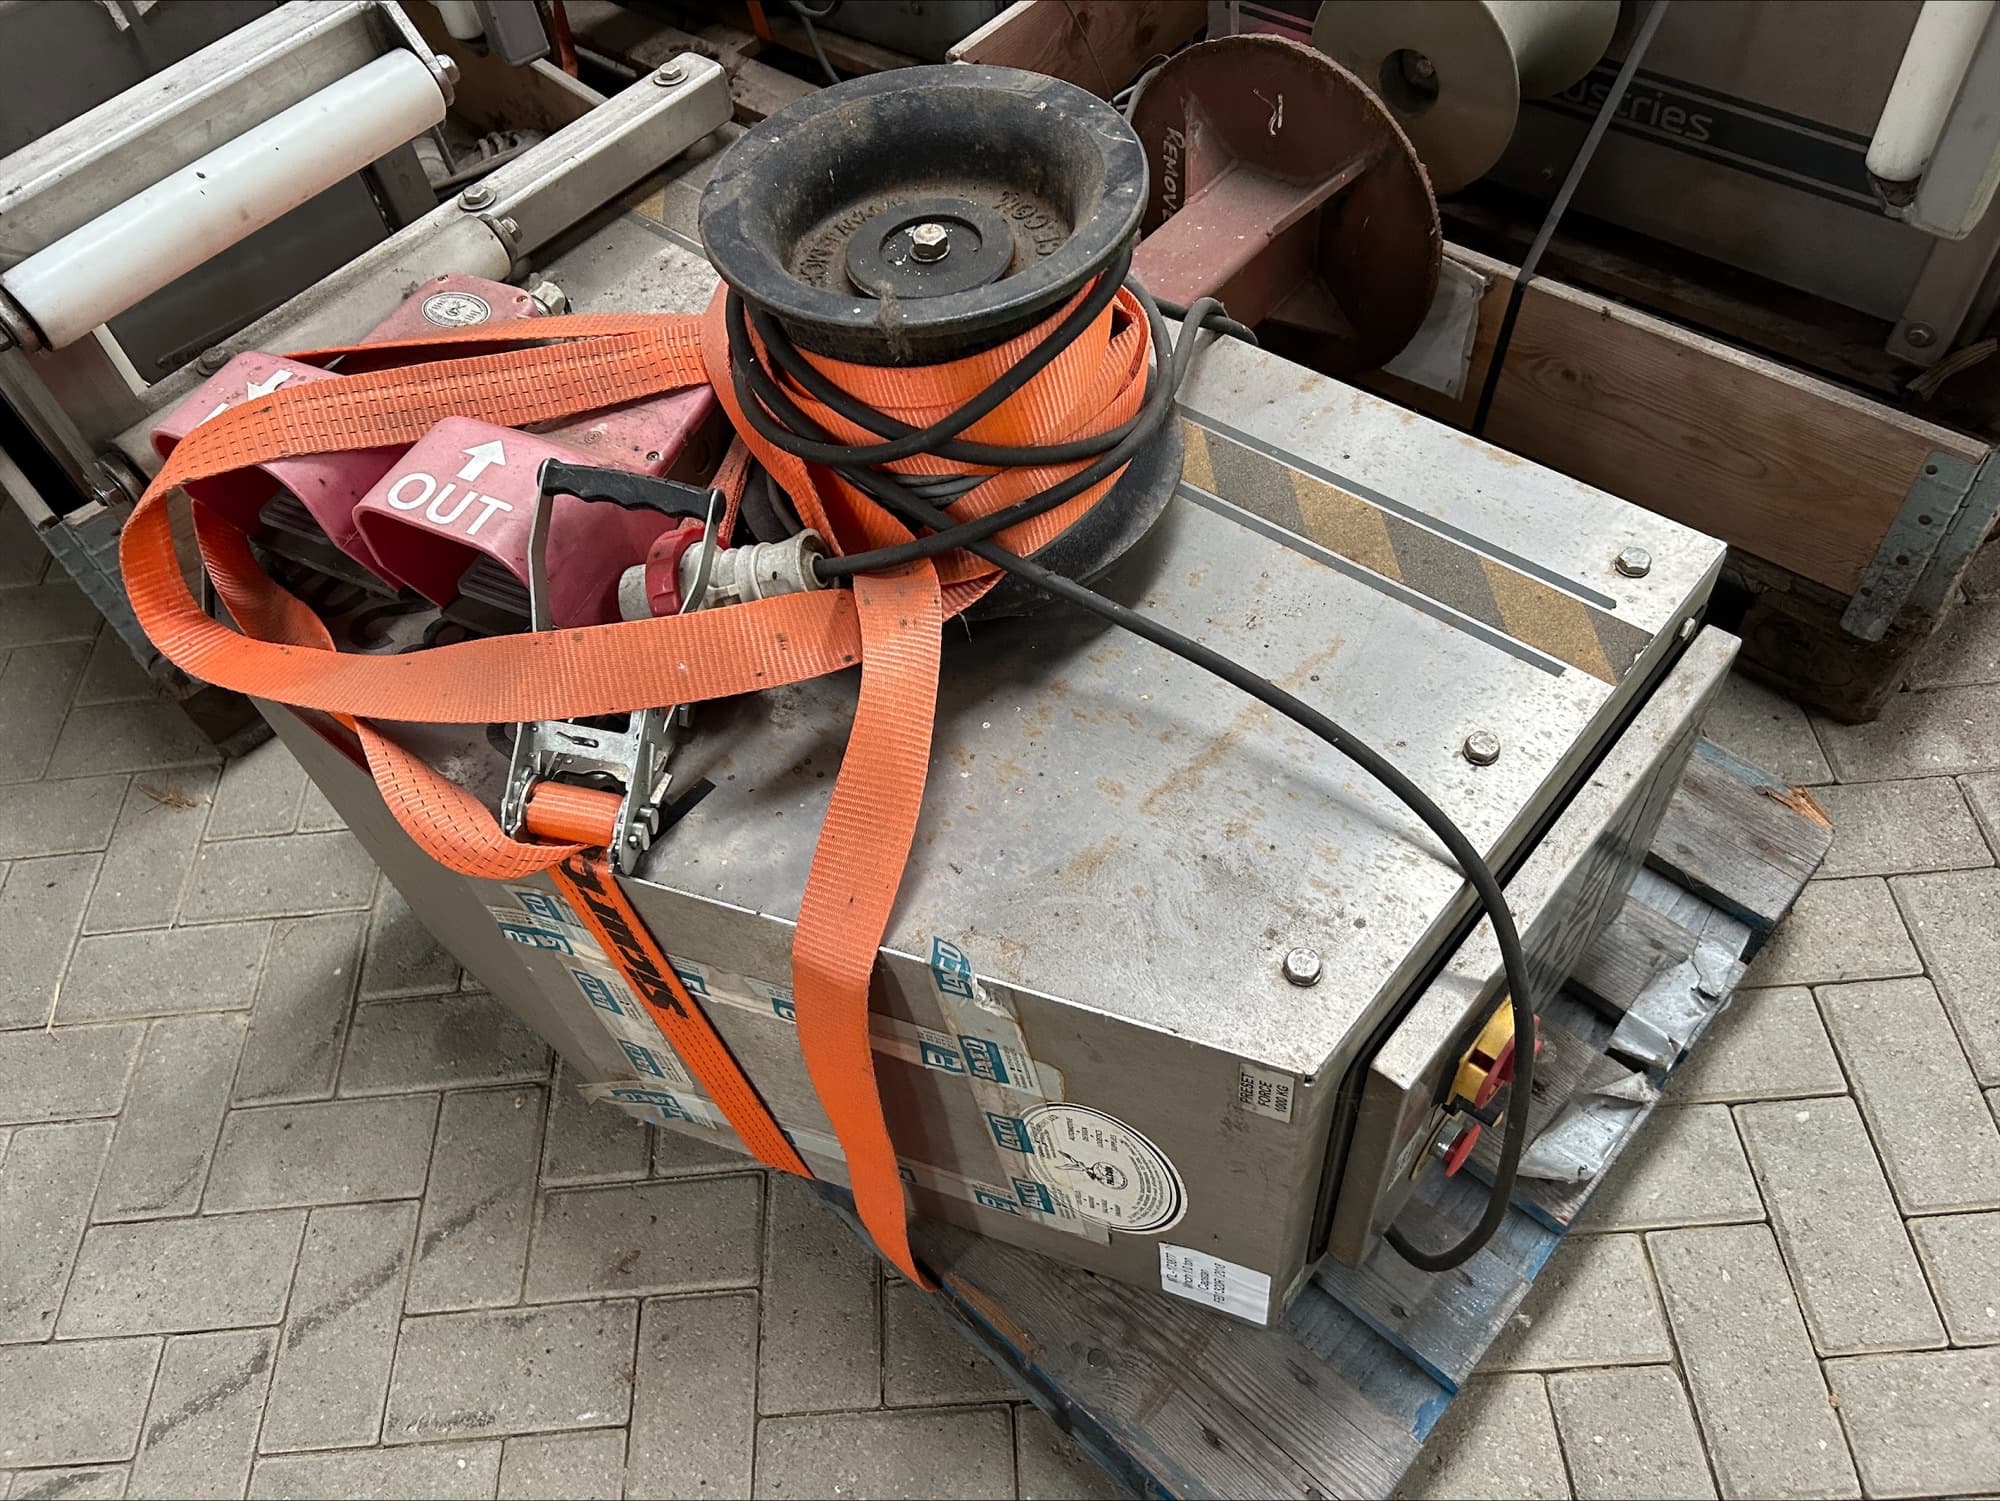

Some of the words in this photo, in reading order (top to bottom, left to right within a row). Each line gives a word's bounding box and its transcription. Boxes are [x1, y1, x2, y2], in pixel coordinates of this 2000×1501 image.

[387, 472, 512, 536] OUT
[937, 939, 968, 997] LACO
[1239, 1072, 1255, 1105] PRESET
[1257, 1080, 1273, 1108] FORCE
[1276, 1084, 1289, 1097] KG
